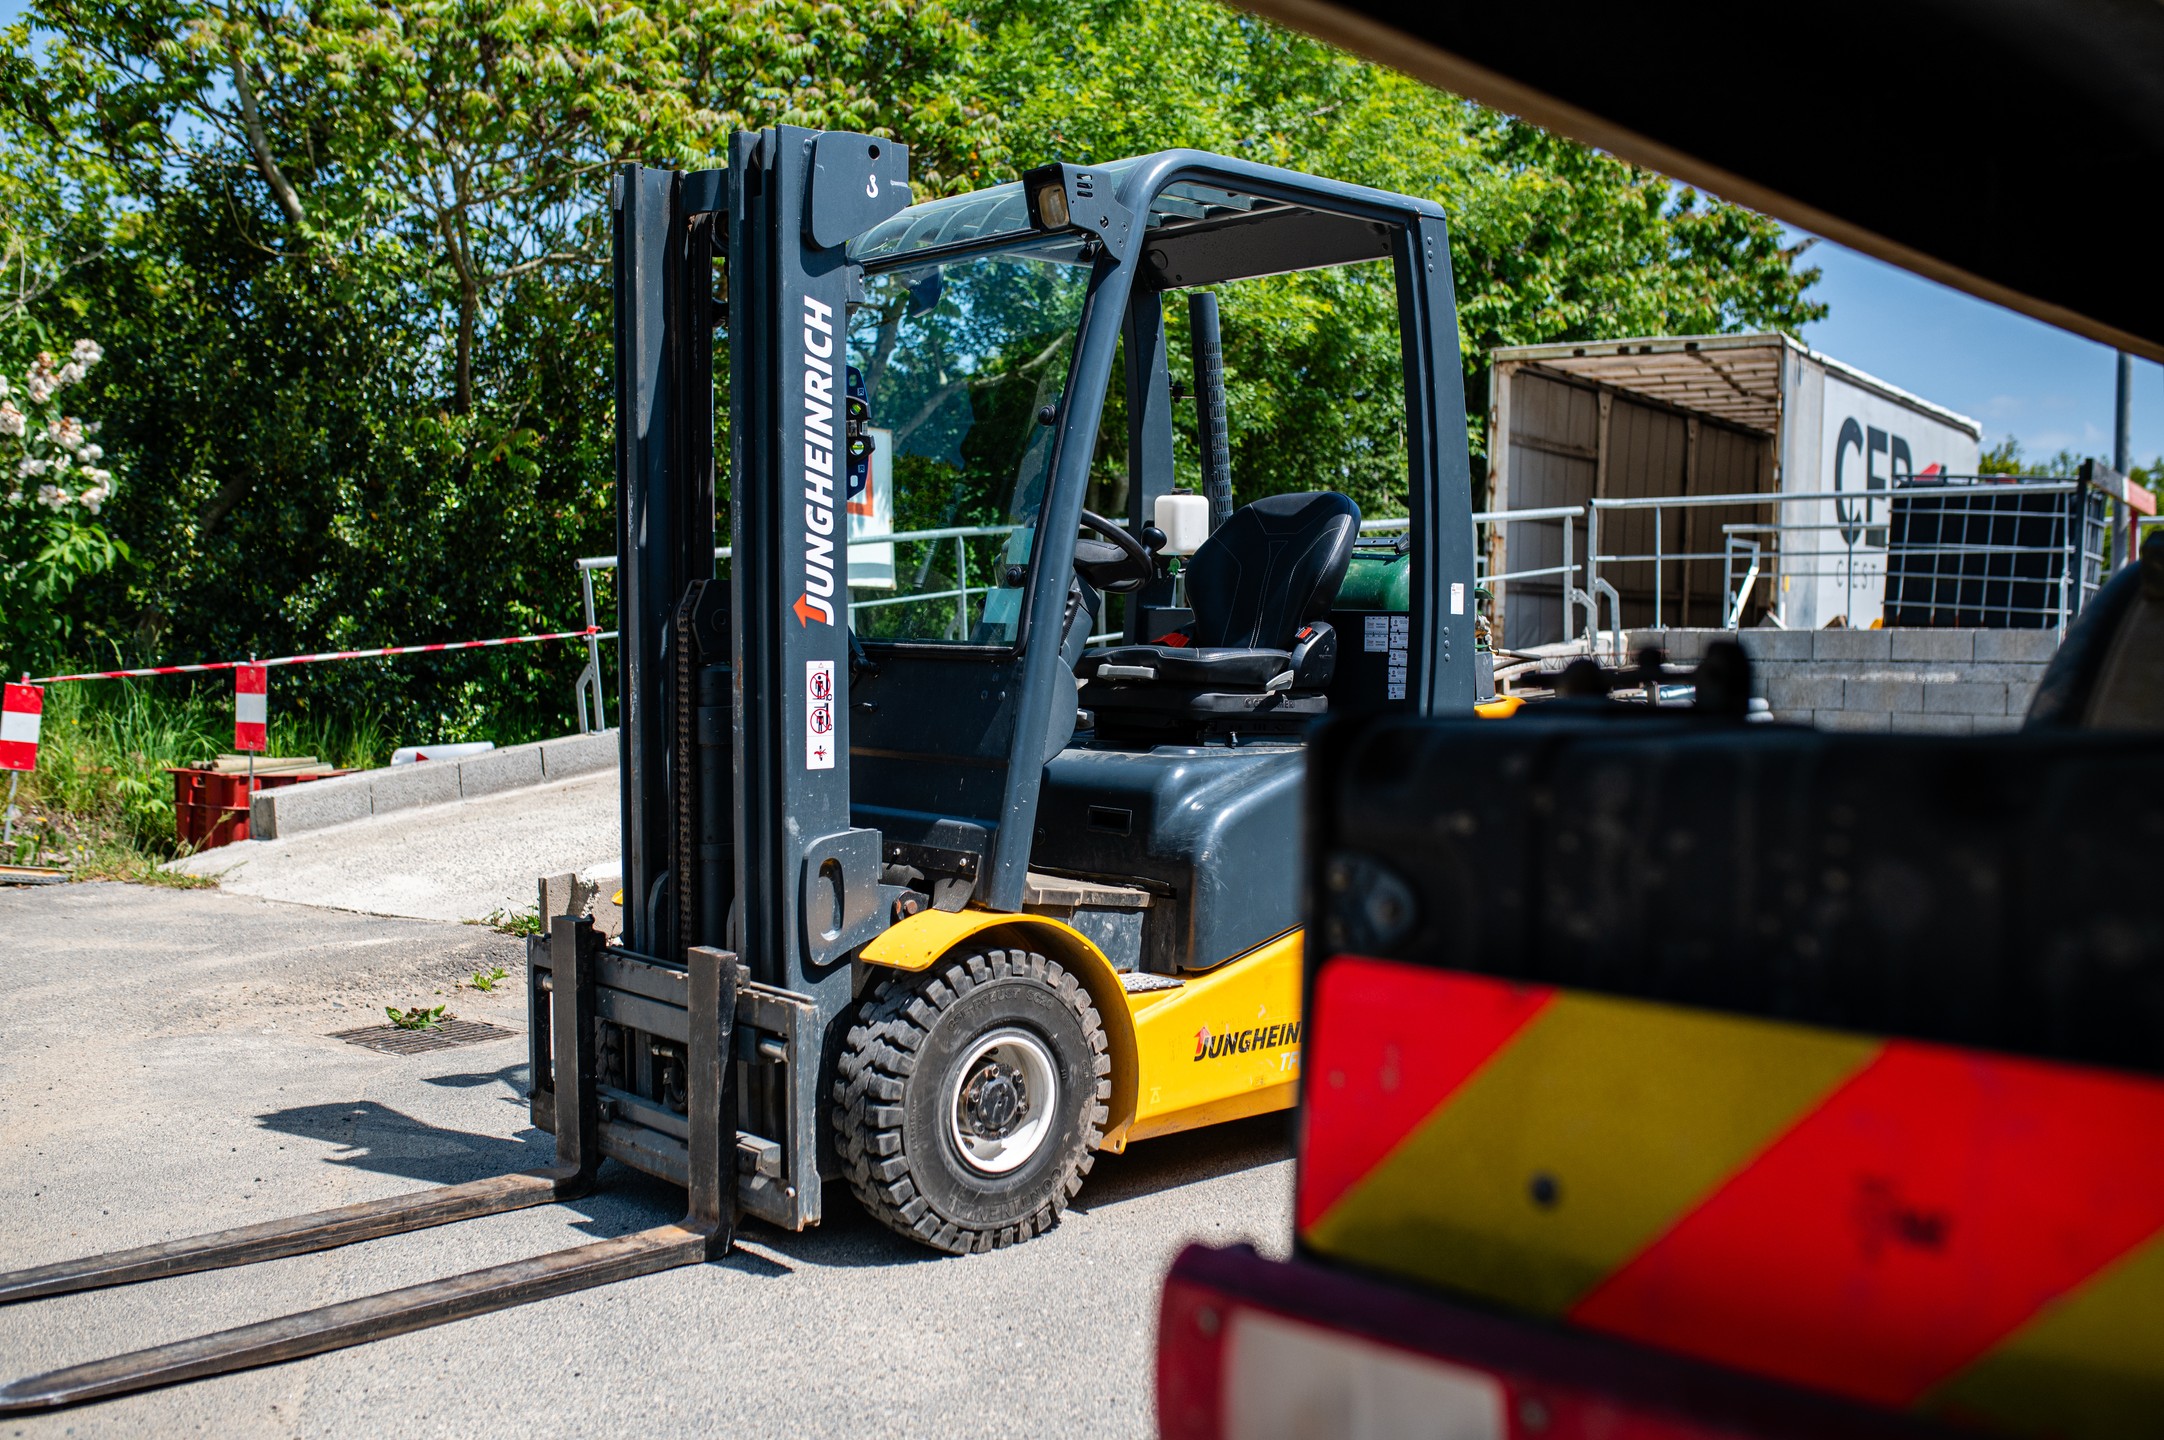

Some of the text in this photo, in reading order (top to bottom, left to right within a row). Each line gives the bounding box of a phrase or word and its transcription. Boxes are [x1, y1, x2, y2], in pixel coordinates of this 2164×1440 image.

[803, 294, 834, 627] JUNGHEINRICH
[1193, 1021, 1301, 1062] JUNGHEIN
[1280, 1050, 1300, 1072] TF
